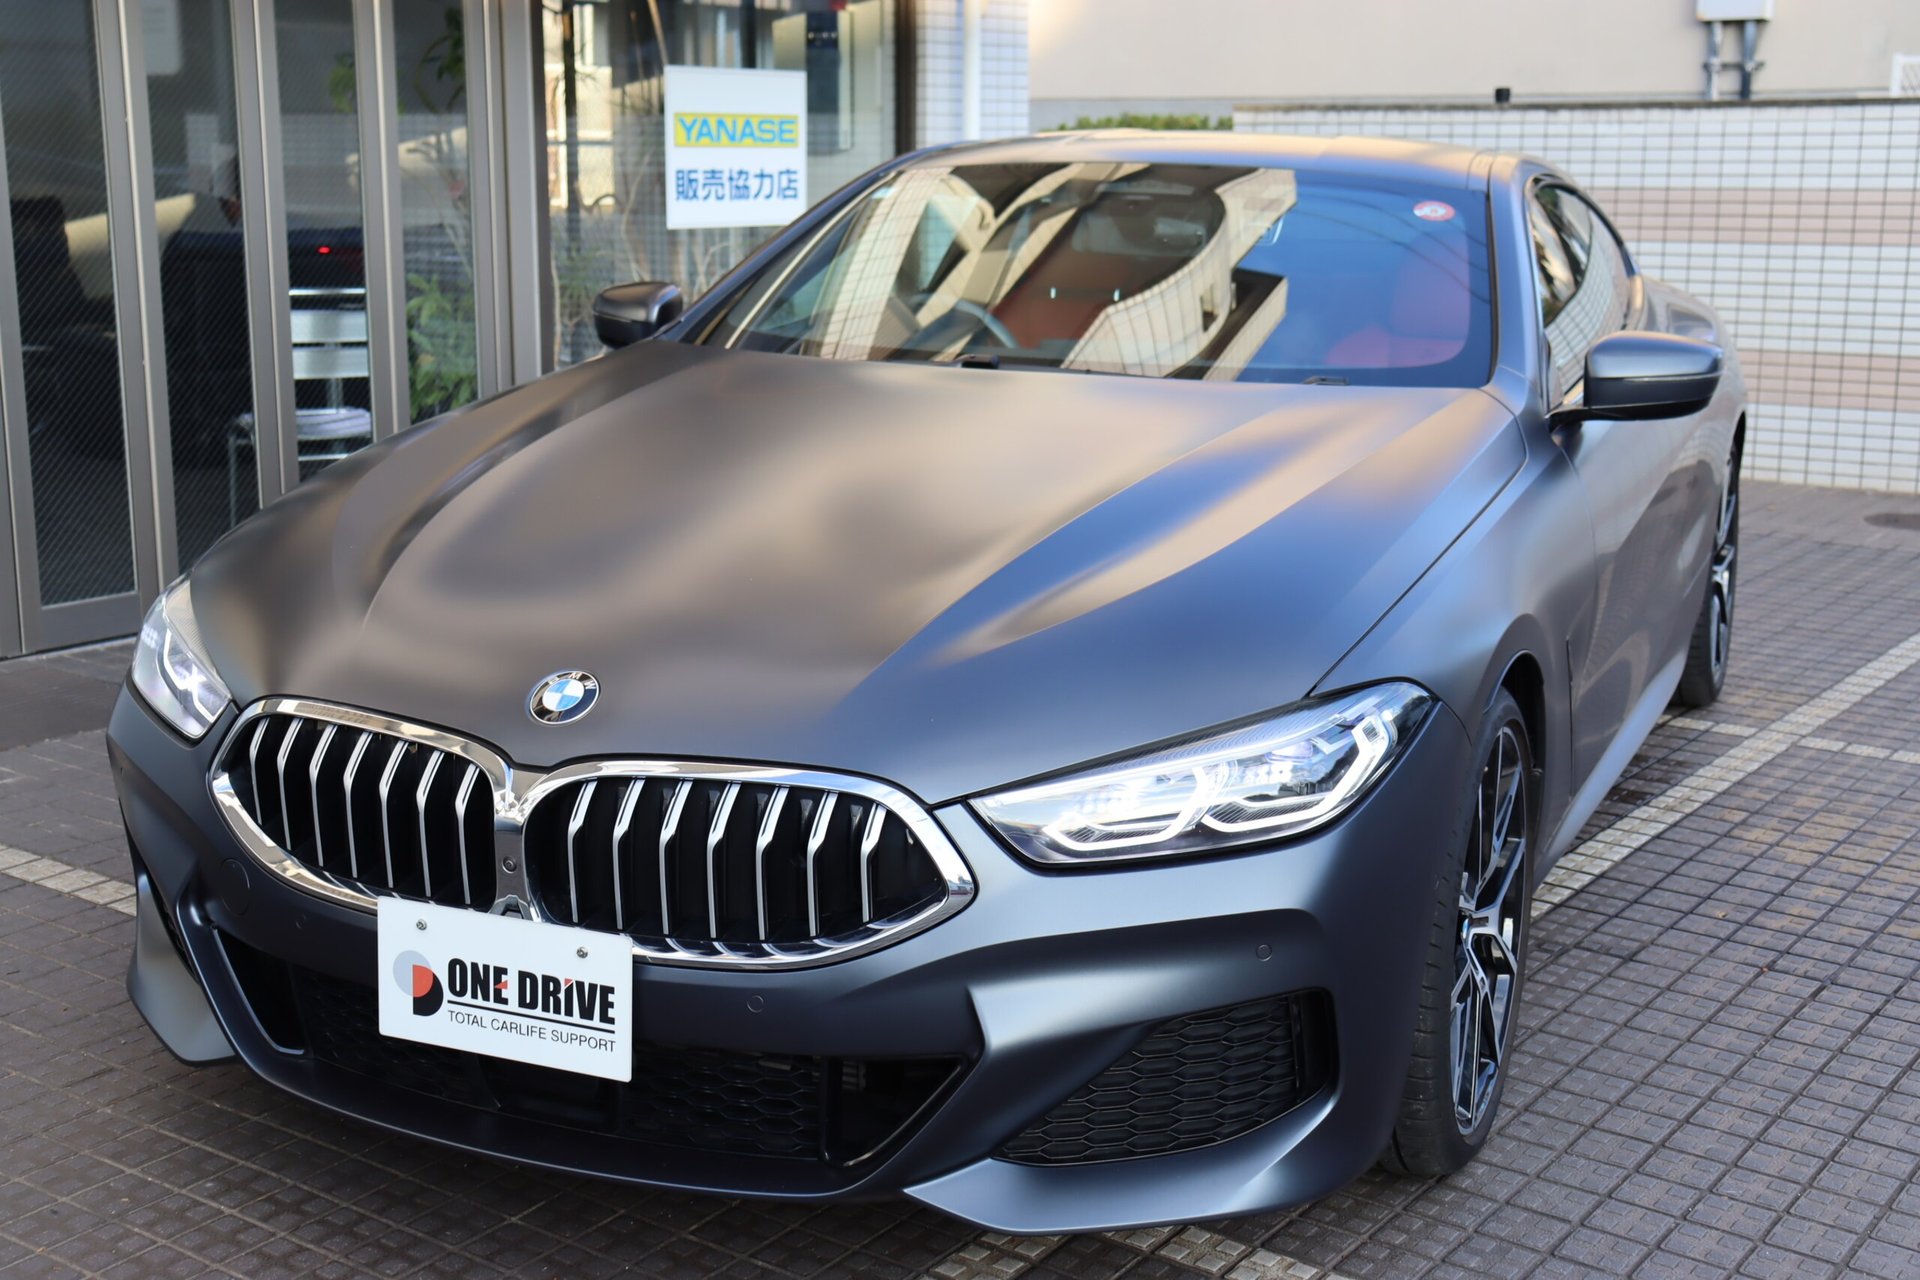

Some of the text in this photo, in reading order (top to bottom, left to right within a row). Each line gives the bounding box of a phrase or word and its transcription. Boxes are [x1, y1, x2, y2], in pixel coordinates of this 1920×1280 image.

[679, 117, 796, 143] YANASE
[676, 169, 798, 200] 販売協力店
[448, 958, 508, 1005] ONE
[447, 1010, 616, 1052] TOTAL CARLIFE SUPPORT
